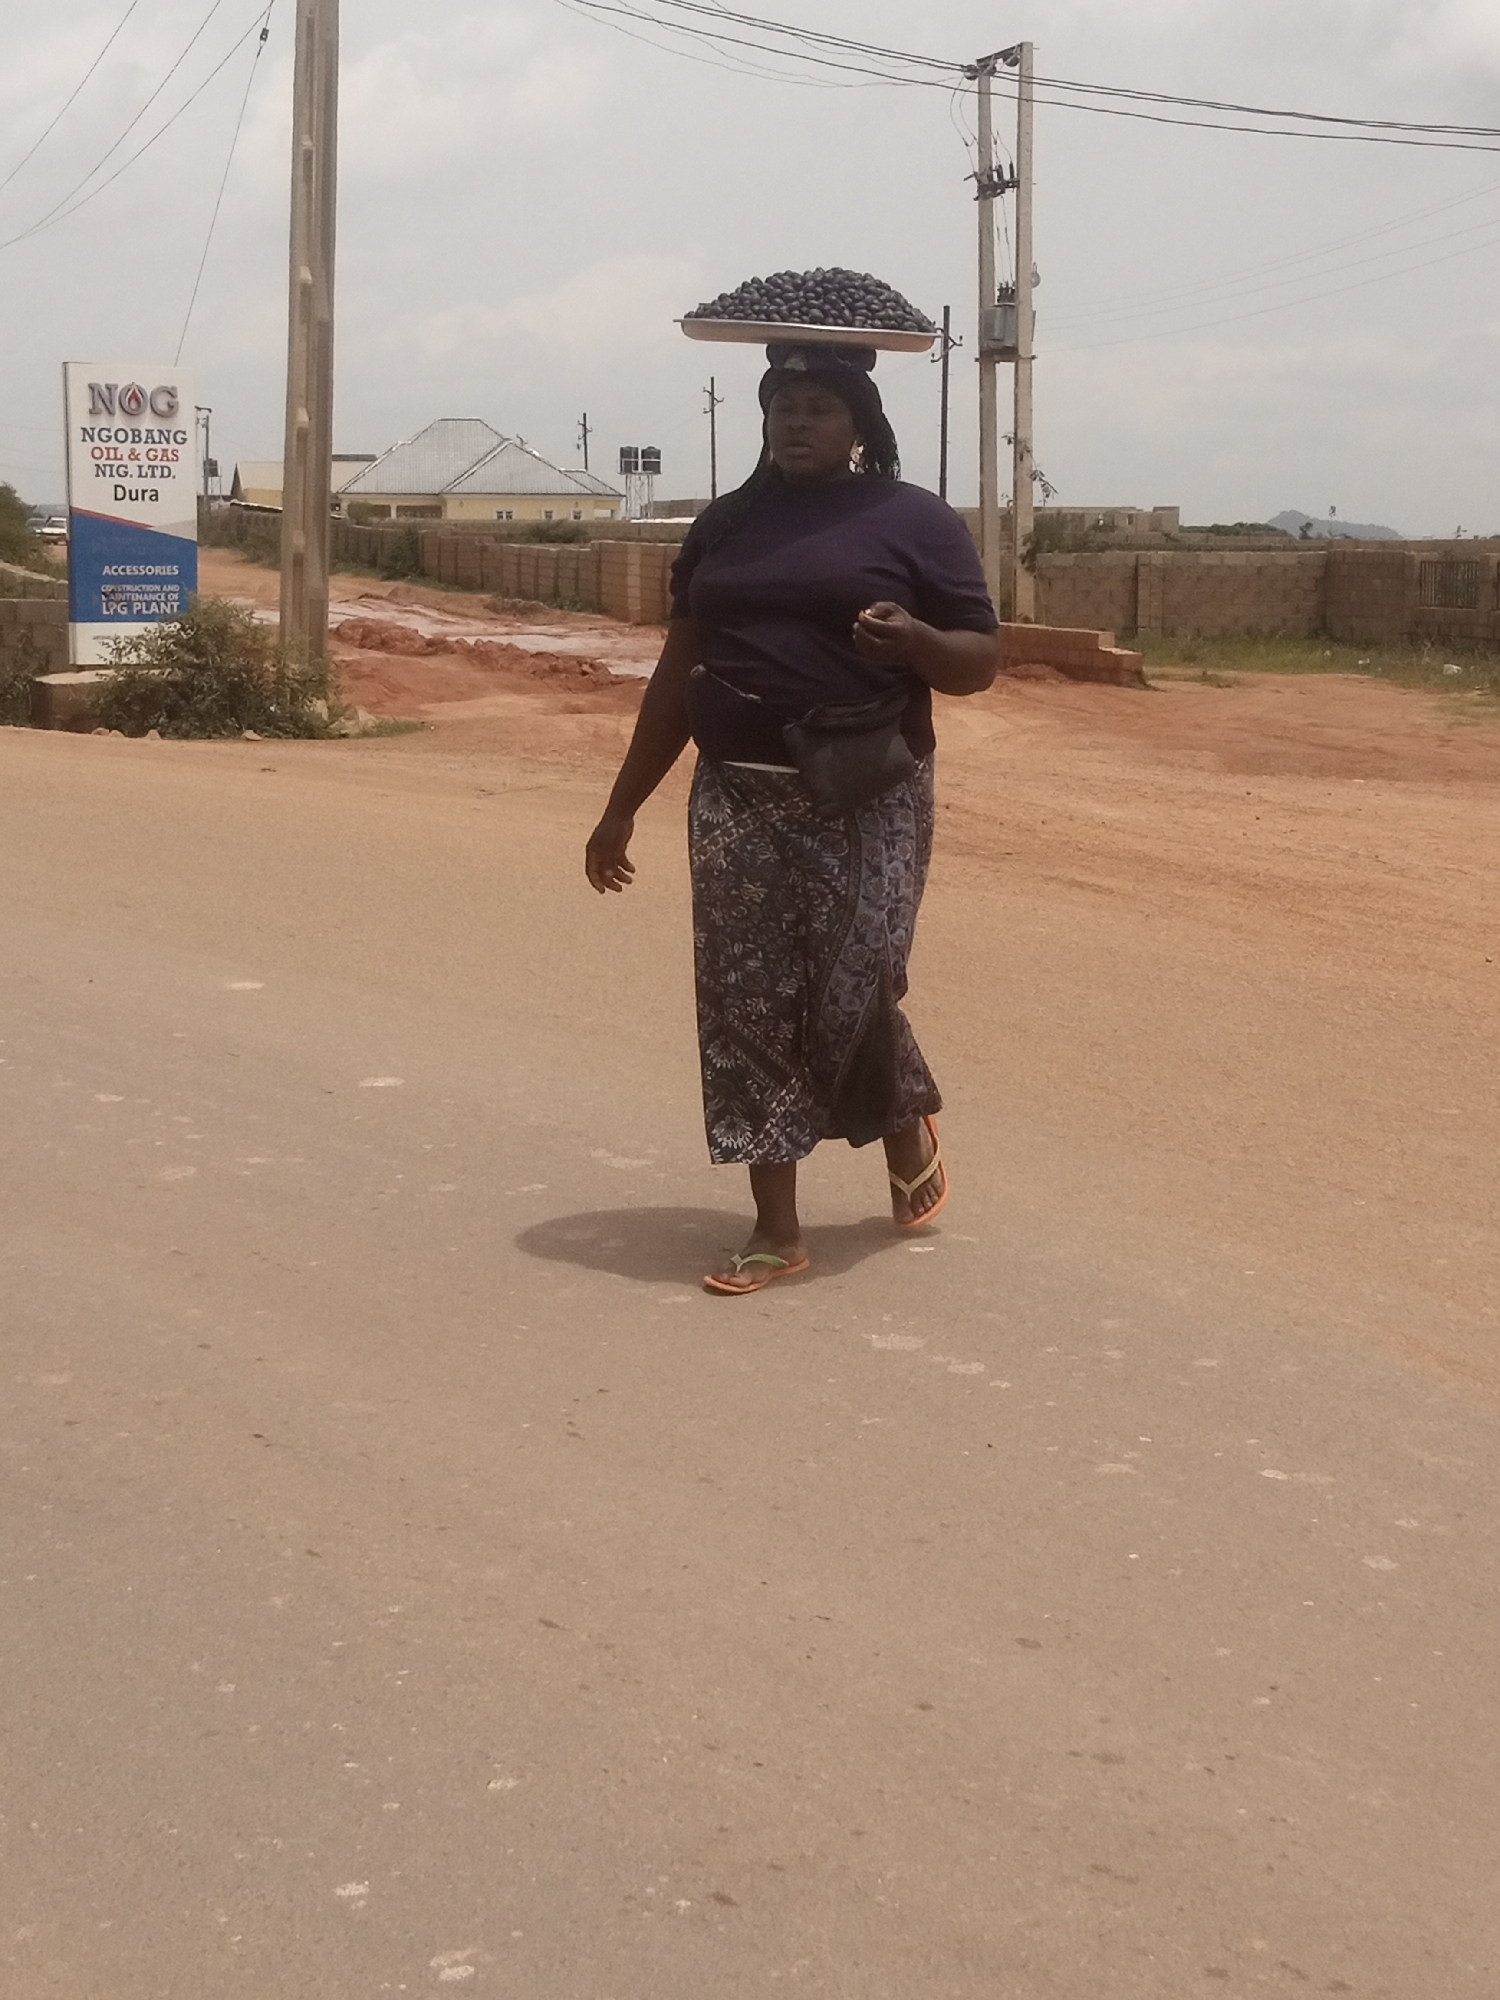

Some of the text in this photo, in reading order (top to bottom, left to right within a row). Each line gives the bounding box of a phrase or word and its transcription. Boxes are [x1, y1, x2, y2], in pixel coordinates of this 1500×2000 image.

[88, 382, 179, 418] NOG
[80, 427, 187, 445] NGOBANG
[91, 446, 180, 462] OIL & GAS
[94, 464, 176, 479] NIG. LTD.
[113, 484, 159, 502] Dura
[102, 565, 179, 576] ACCESSORIES
[162, 584, 180, 592] AND
[167, 592, 179, 600] OF
[102, 601, 180, 615] LPG PLANT
